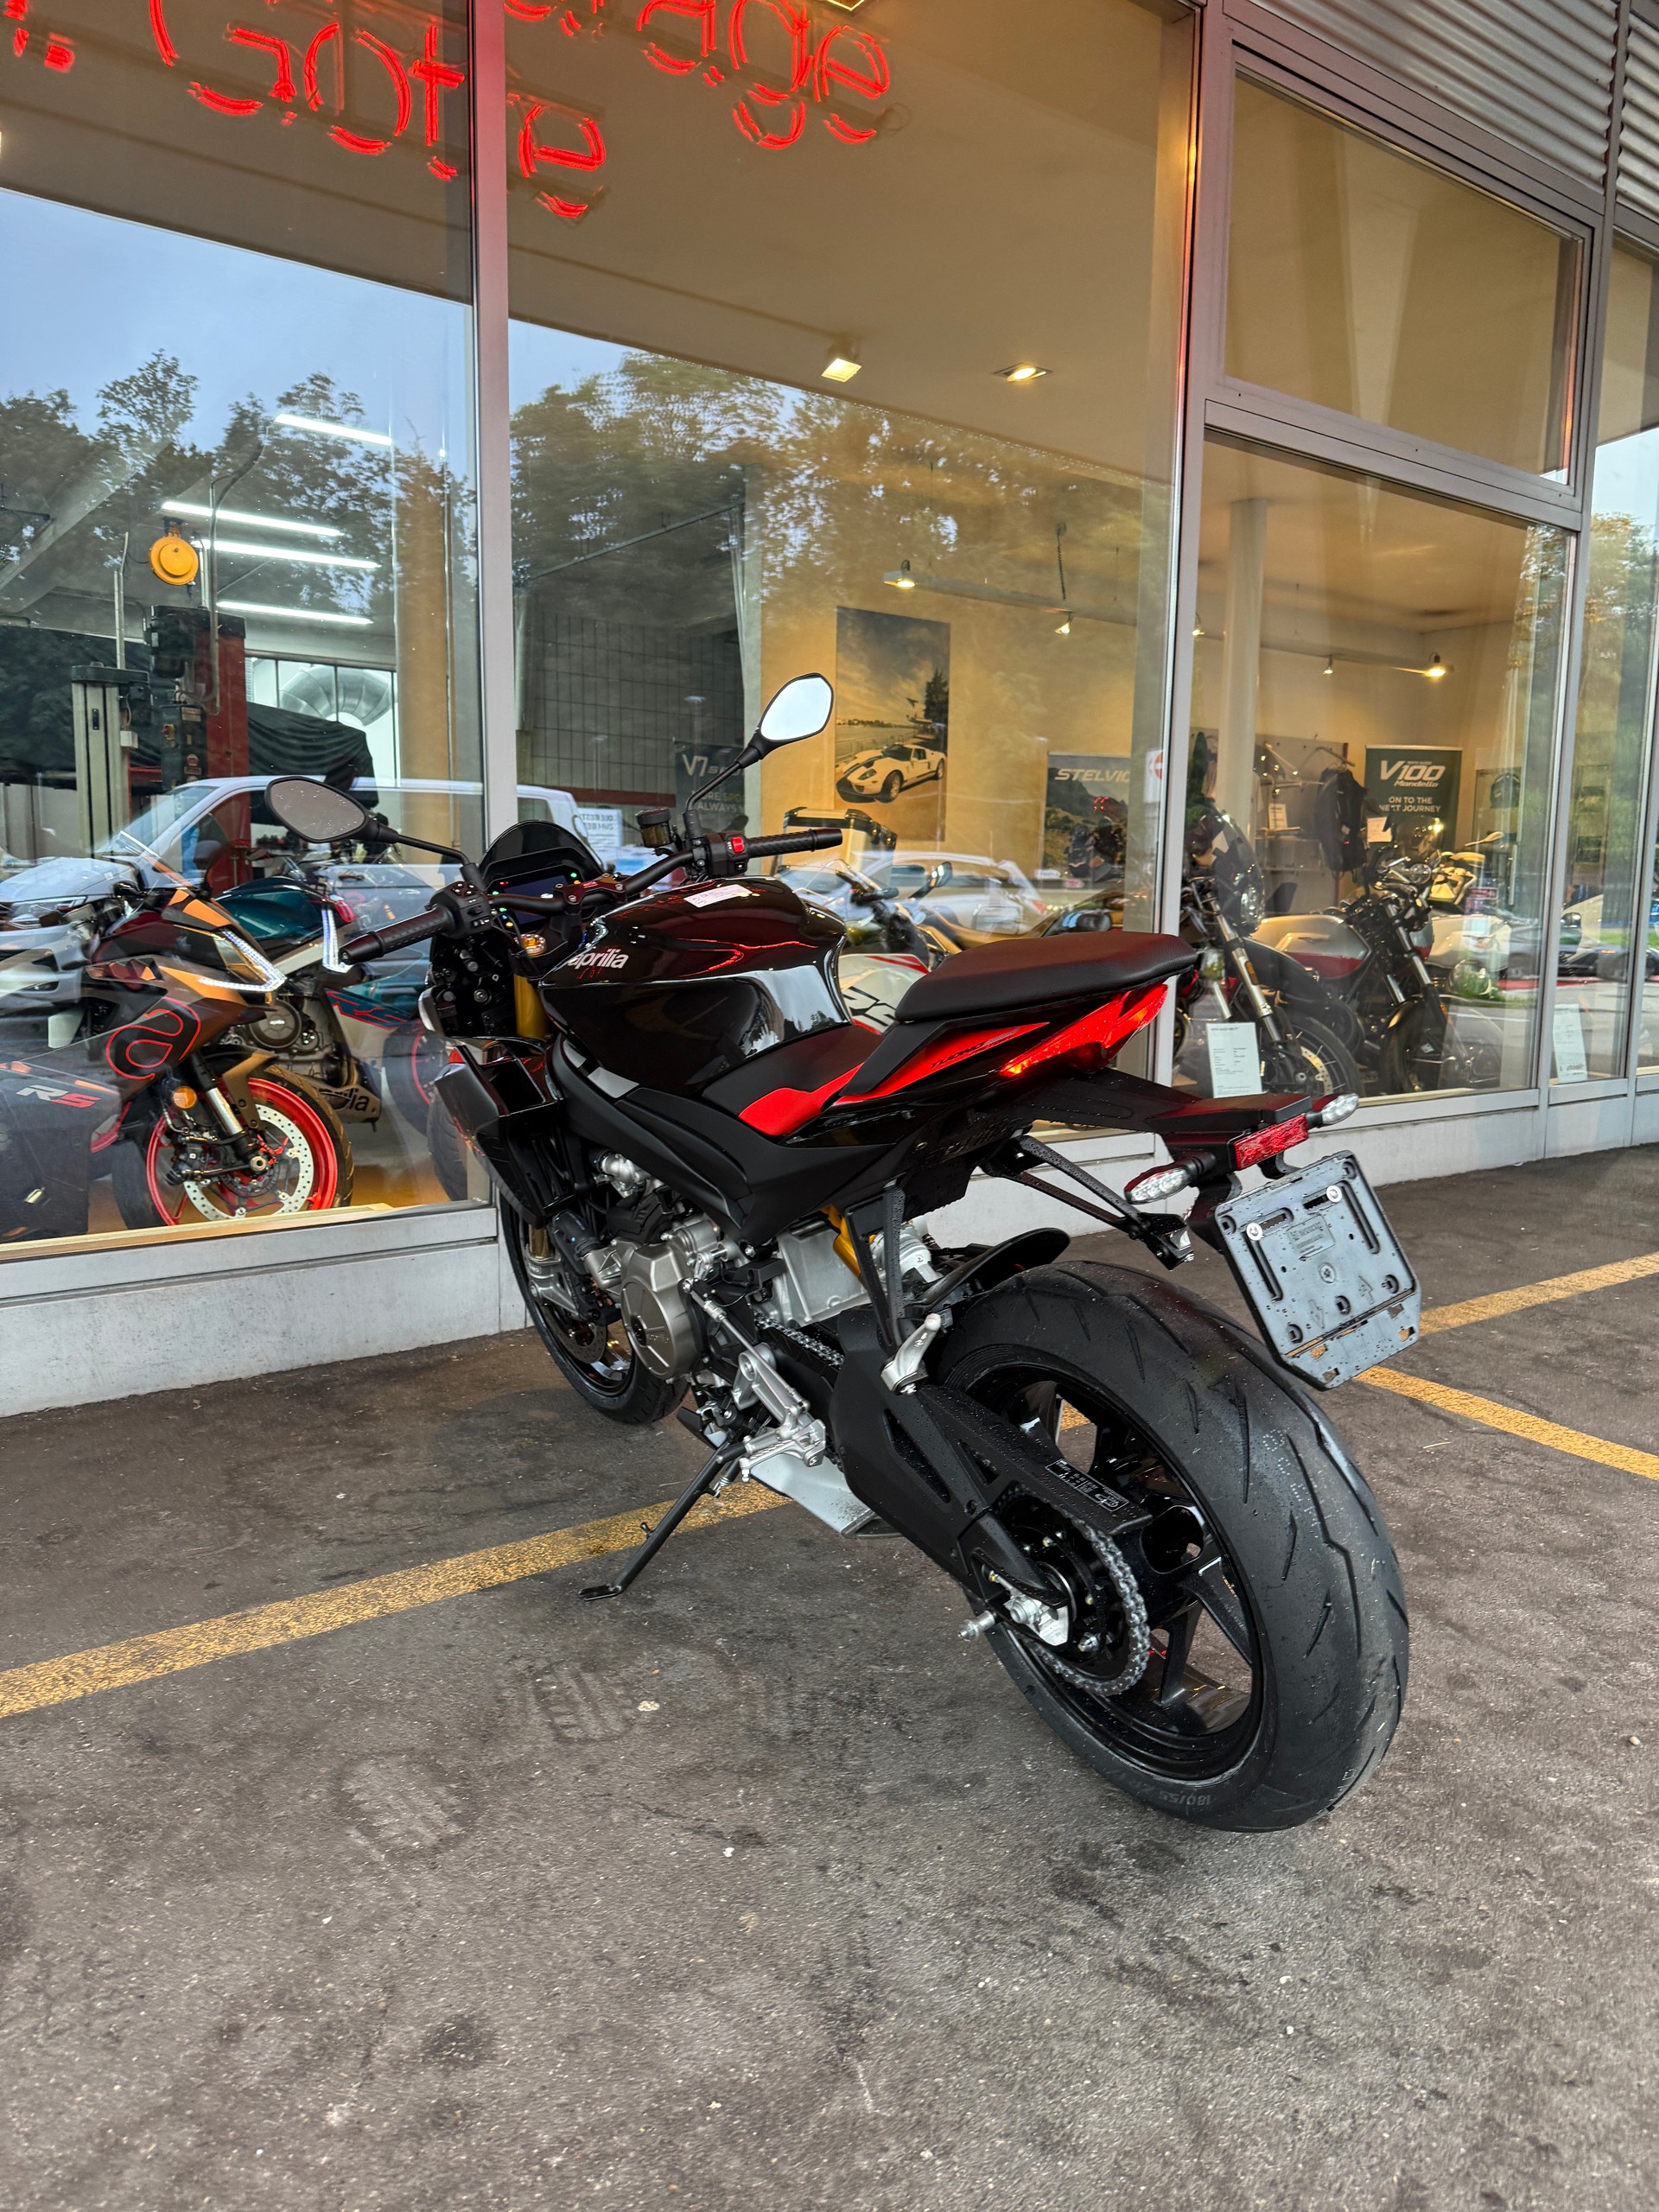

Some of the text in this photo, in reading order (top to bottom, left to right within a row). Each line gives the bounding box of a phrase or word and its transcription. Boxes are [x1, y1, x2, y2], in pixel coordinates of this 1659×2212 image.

[682, 753, 709, 777] V7
[1380, 760, 1446, 781] V100
[567, 948, 629, 969] aprilia
[16, 1084, 101, 1108] RS
